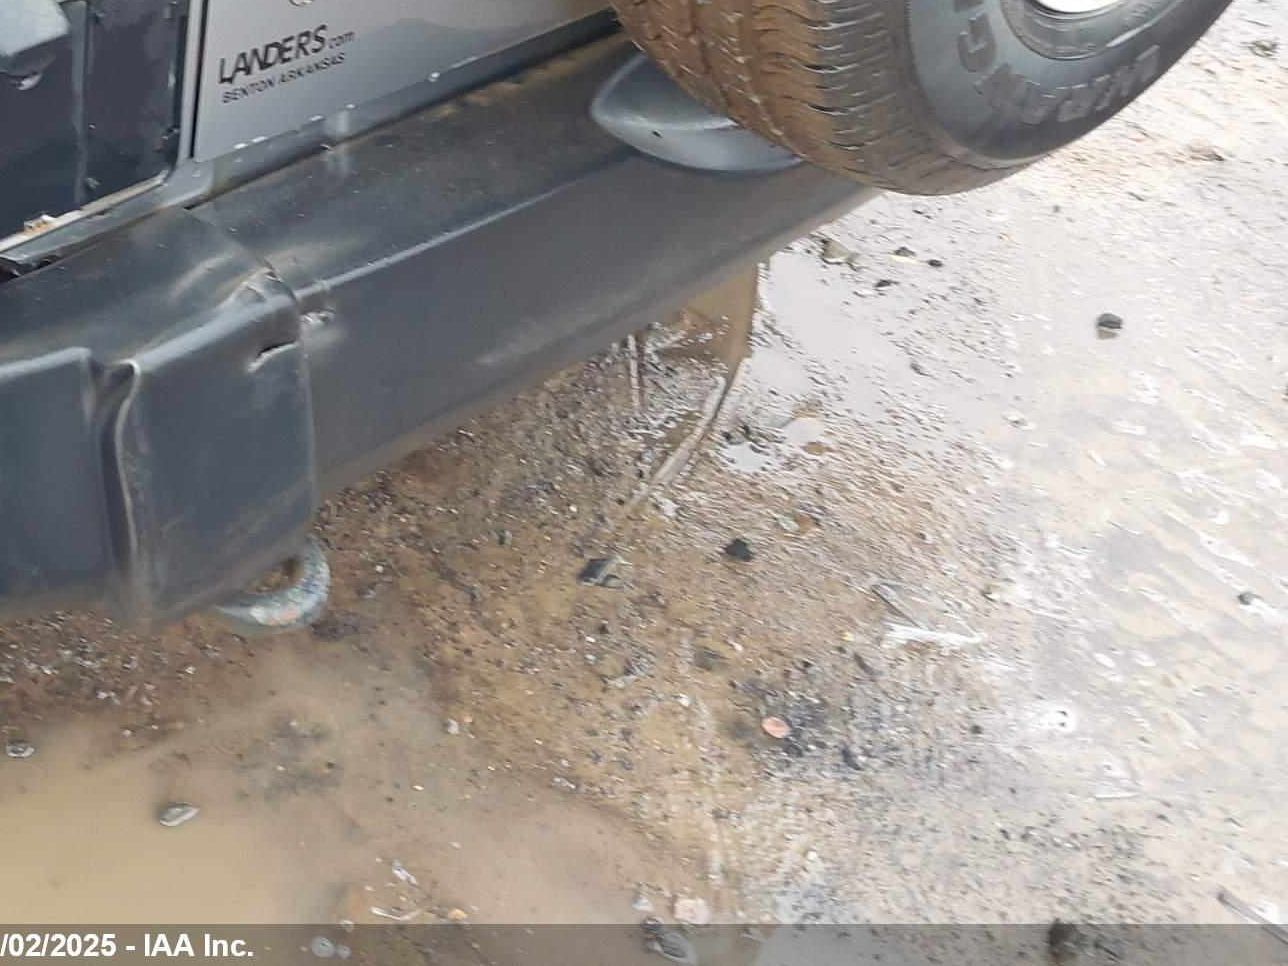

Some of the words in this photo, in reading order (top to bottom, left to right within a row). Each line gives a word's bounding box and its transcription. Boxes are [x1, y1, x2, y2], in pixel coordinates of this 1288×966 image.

[218, 24, 327, 84] LANDERS
[222, 77, 276, 104] BENTON
[279, 52, 345, 85] ARKANSAS
